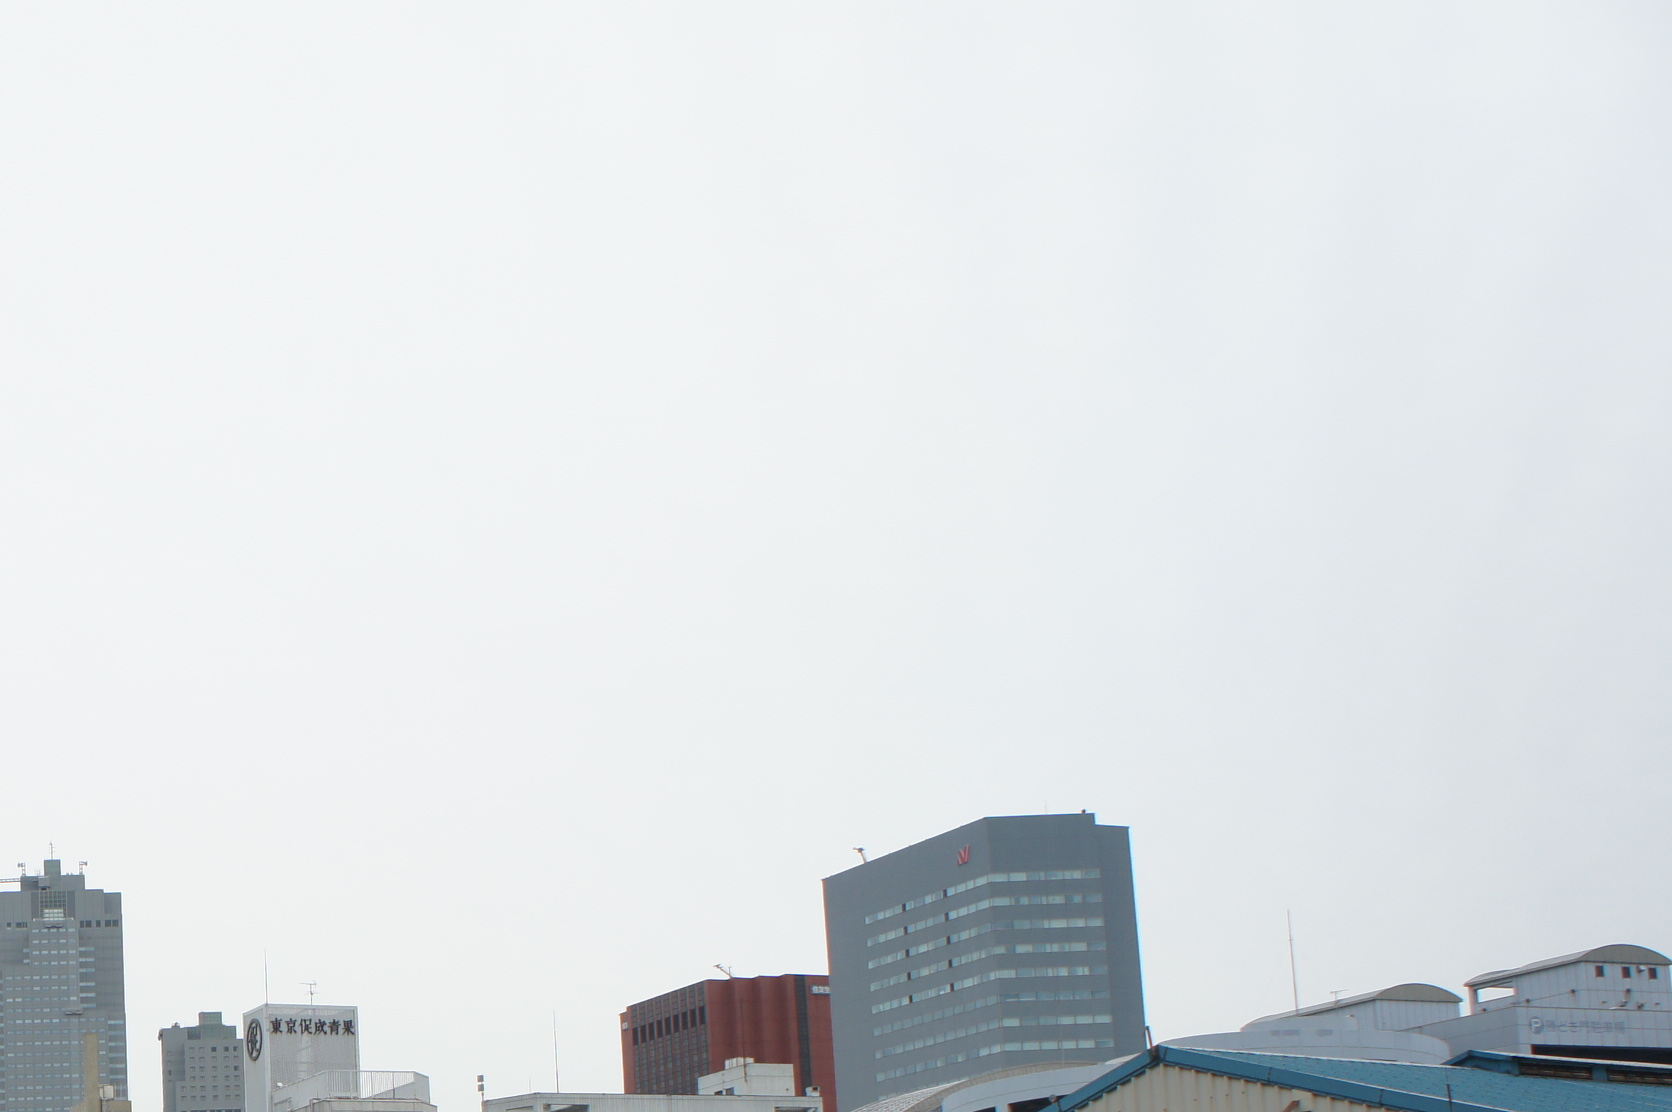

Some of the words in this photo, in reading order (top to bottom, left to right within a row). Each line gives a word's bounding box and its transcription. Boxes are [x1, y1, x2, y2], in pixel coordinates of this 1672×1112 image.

[270, 1017, 355, 1035] 東京促成青果
